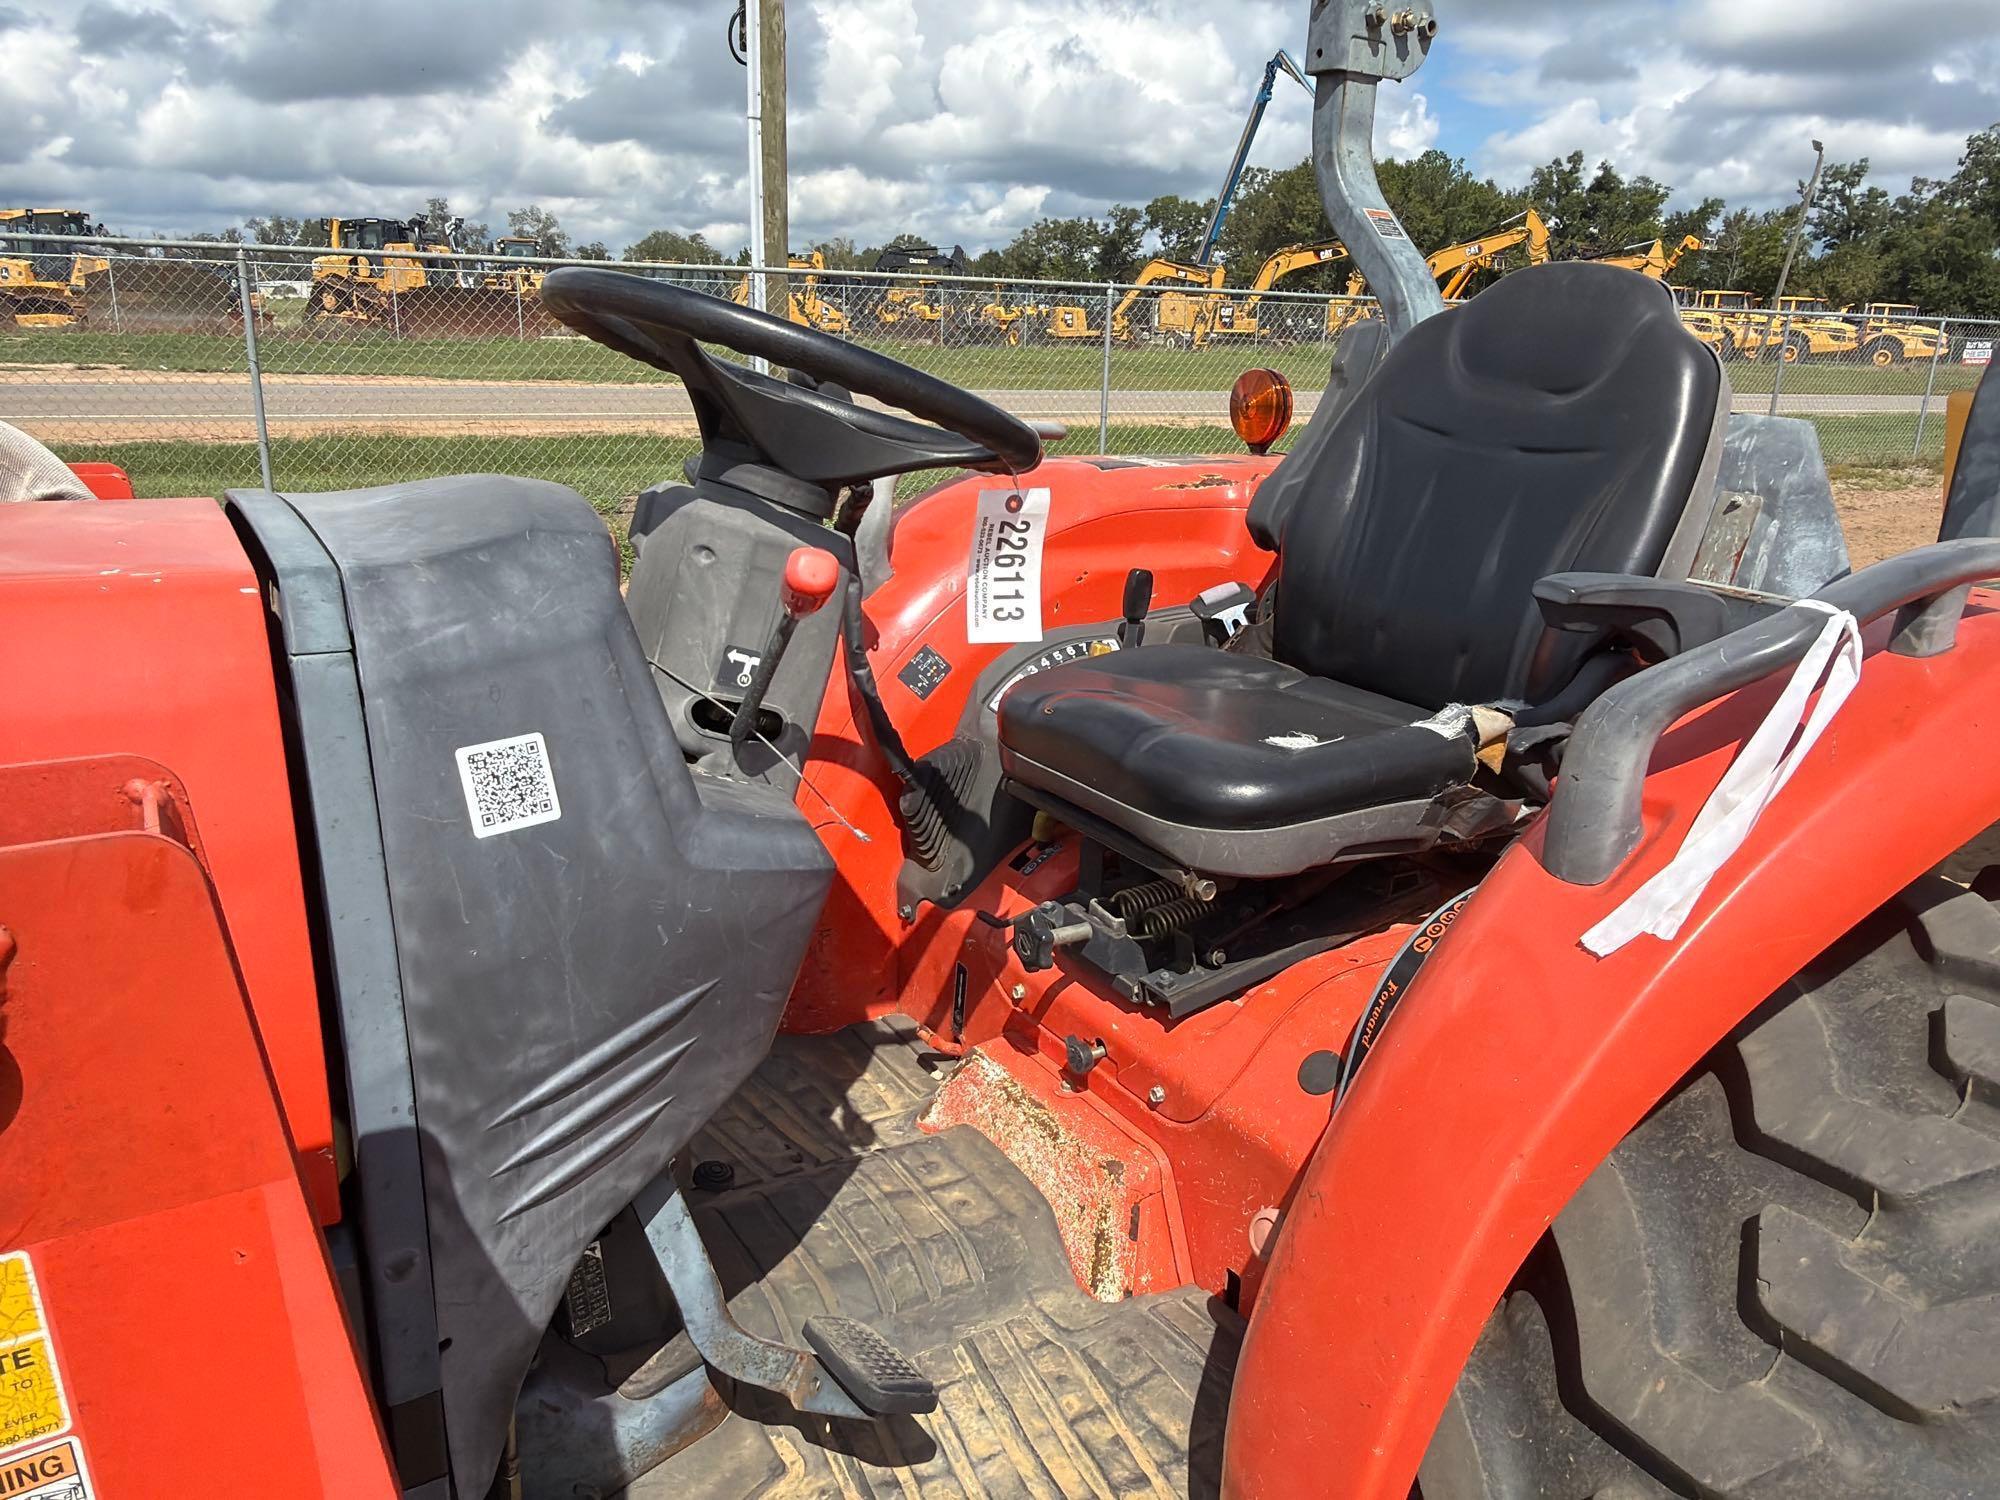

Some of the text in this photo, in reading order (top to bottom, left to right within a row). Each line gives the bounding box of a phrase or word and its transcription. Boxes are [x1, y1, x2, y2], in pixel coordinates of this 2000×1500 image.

[1320, 249, 1333, 259] CAT
[980, 523, 995, 619] REBEL AUCTION COMPANY
[992, 520, 1031, 622] 226113
[1041, 657, 1050, 667] 4
[1052, 651, 1063, 660] 5
[1066, 646, 1076, 655] 6
[1079, 642, 1087, 652] 7
[1361, 980, 1398, 1048] Forward
[10, 1379, 33, 1392] TO
